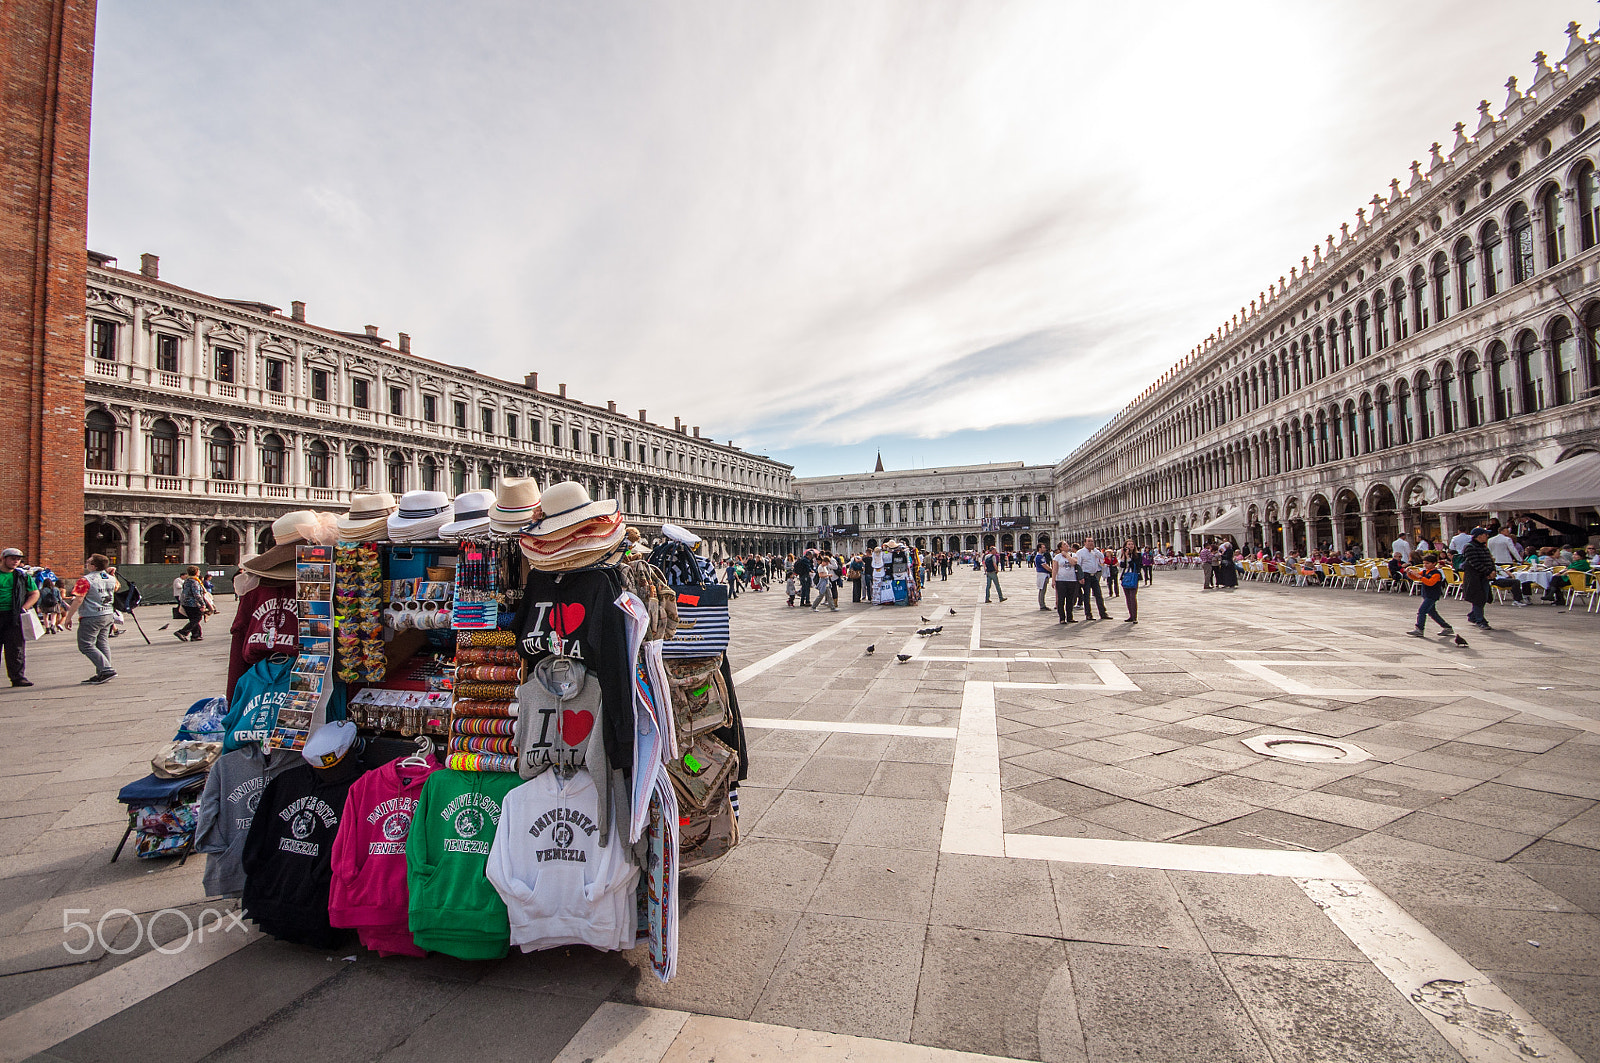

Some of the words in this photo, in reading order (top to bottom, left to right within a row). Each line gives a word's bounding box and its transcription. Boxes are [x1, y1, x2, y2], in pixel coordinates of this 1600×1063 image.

[527, 602, 553, 638] I
[522, 637, 584, 660] ITAIA
[532, 708, 556, 748] I
[536, 847, 587, 863] VENEZIA
